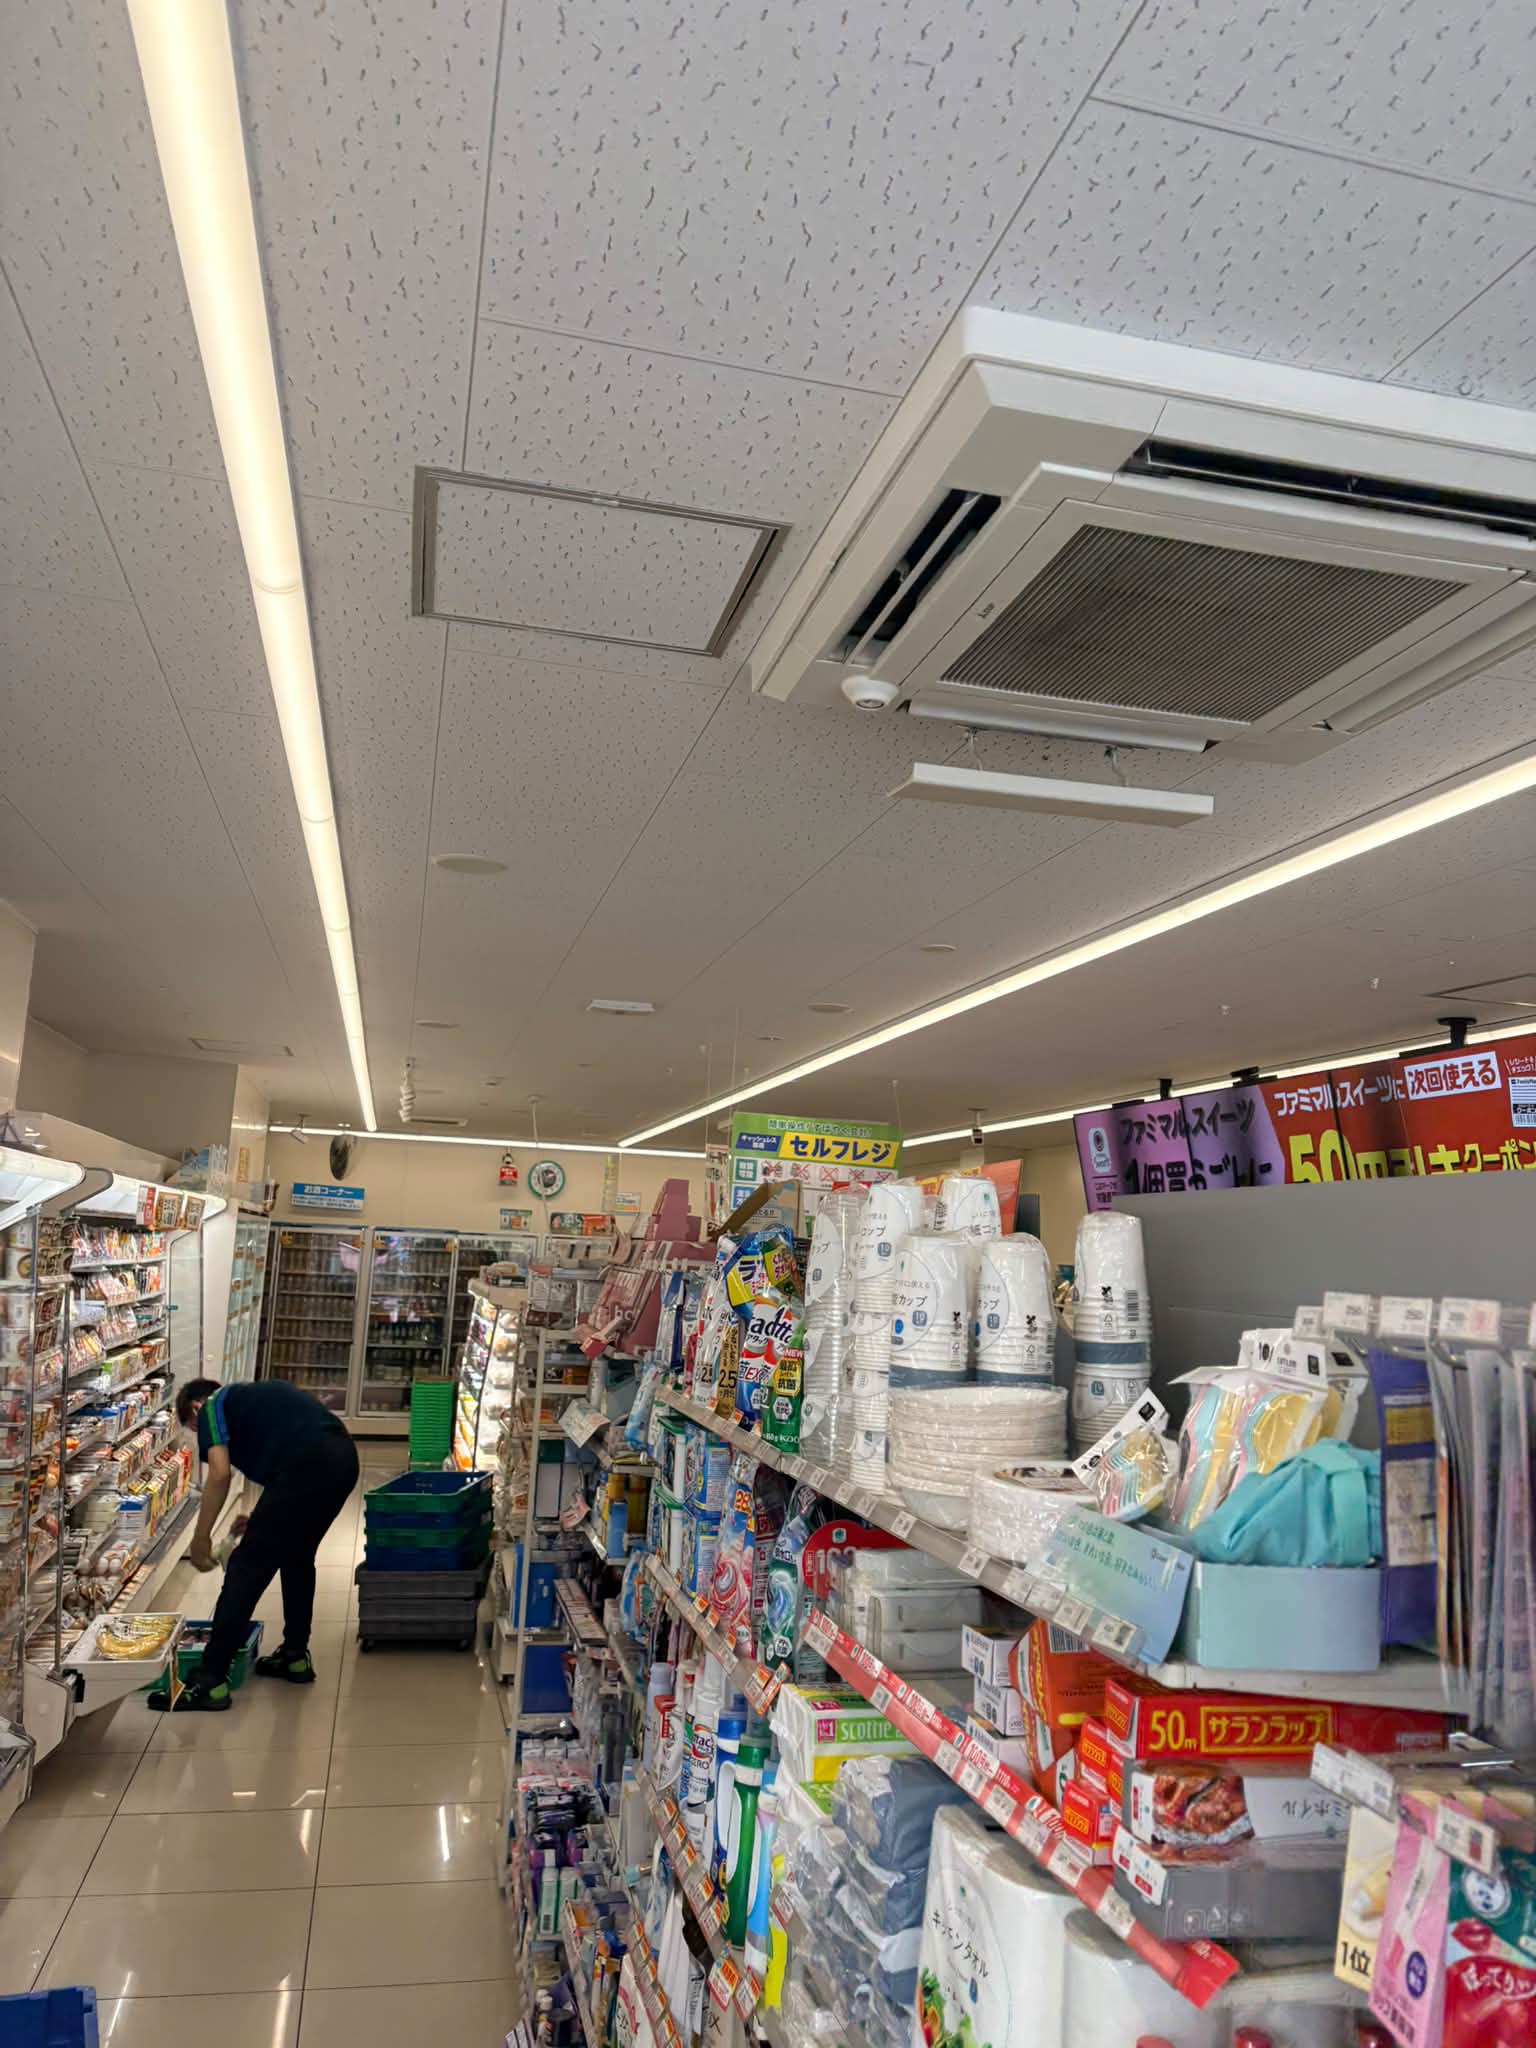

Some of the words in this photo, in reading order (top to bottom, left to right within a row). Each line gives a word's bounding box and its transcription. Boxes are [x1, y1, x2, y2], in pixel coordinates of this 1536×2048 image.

[1273, 1075, 1406, 1116] ファミマルスイーツに
[1409, 1059, 1495, 1096] 次回使える
[1119, 1100, 1256, 1145] ファミマルスイーツ
[789, 1135, 893, 1163] セルフレジ
[841, 1720, 892, 1741] scottie
[1209, 1714, 1327, 1744] サランラップ
[1281, 1799, 1342, 1820] ミホイル
[1340, 1940, 1372, 1977] 1位
